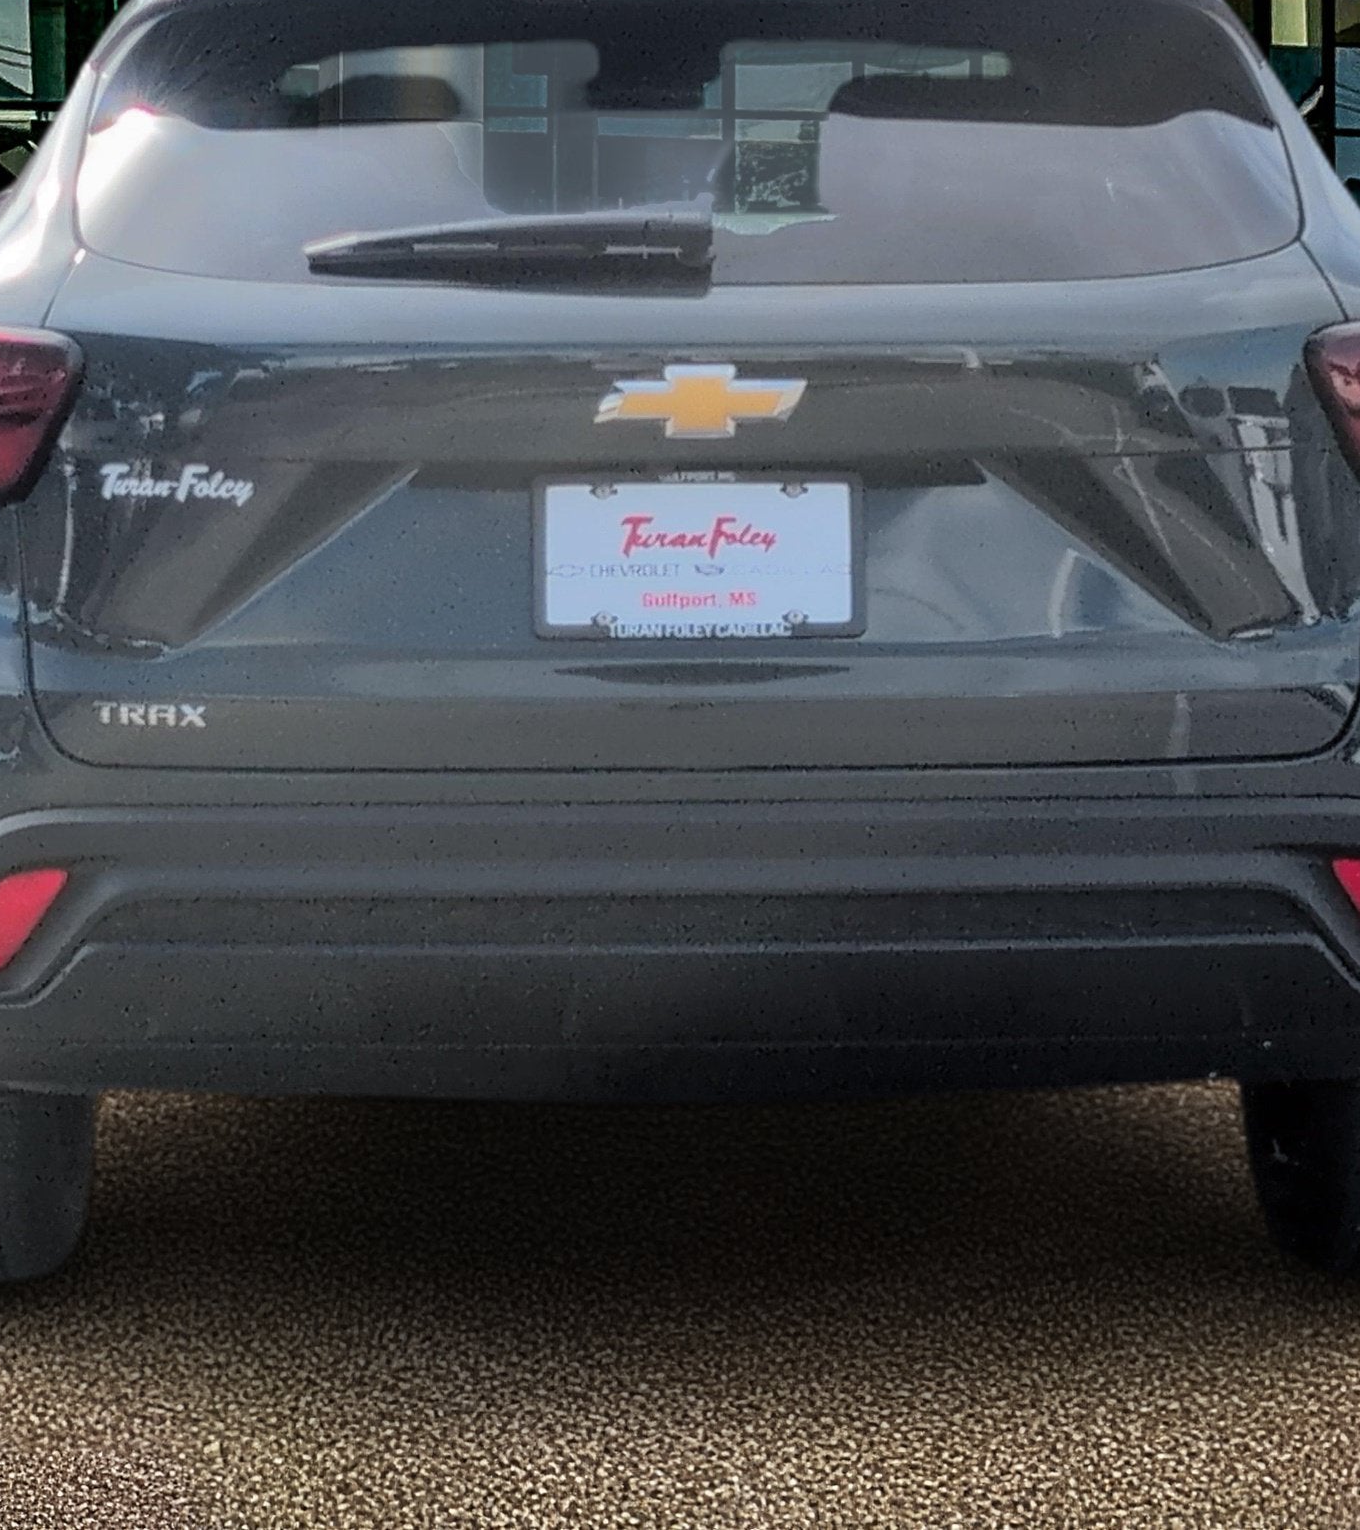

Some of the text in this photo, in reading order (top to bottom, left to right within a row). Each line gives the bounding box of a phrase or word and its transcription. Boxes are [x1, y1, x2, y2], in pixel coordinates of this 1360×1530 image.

[621, 516, 777, 559] Turan Foley
[590, 564, 680, 577] CHEVROLET
[729, 592, 757, 606] MS
[609, 624, 663, 638] TURAN
[665, 624, 714, 638] FOLEY
[94, 700, 207, 728] TRAX
